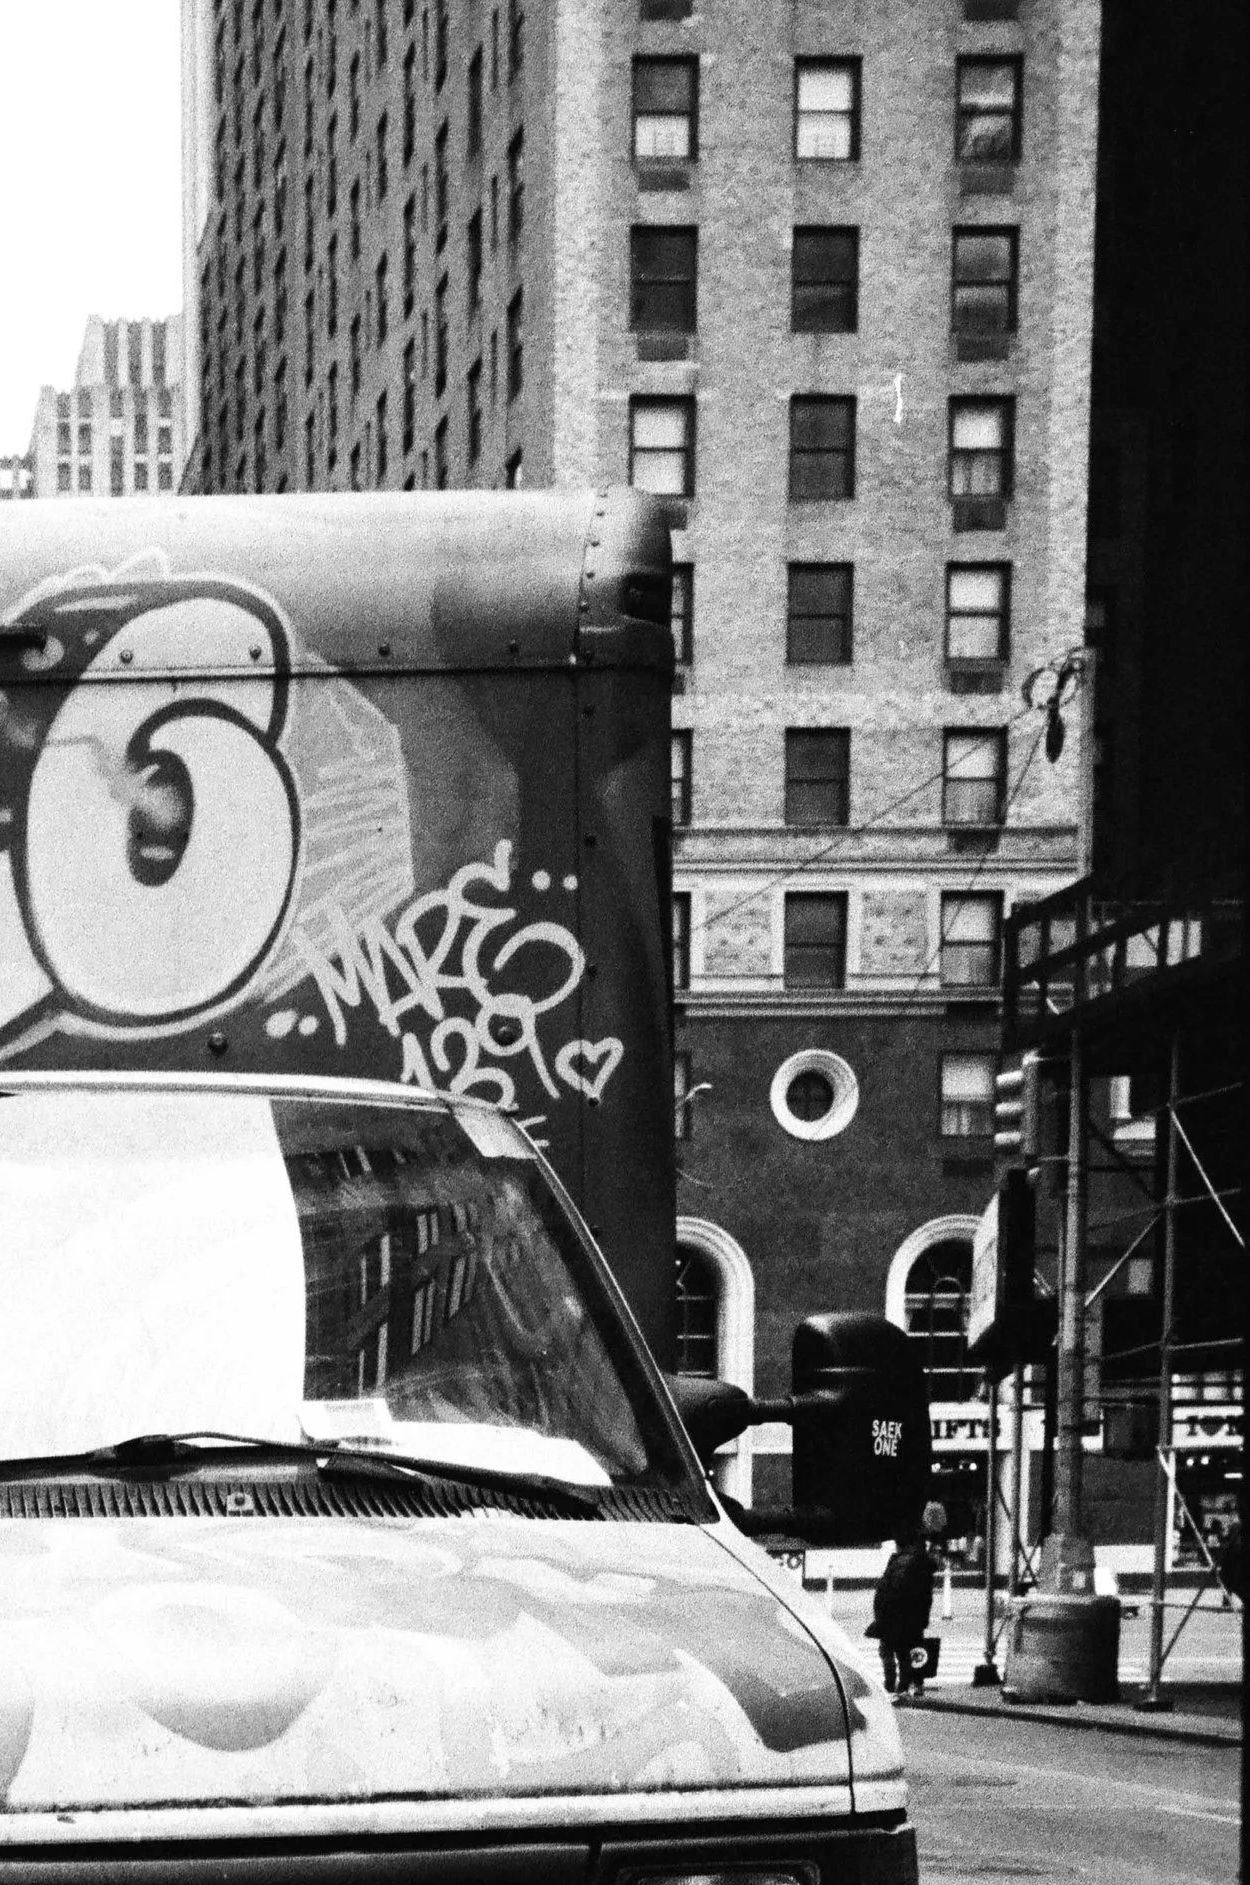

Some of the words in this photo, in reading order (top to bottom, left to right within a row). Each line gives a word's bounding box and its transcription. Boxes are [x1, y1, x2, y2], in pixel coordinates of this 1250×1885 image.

[871, 1418, 903, 1440] SAEK
[931, 1418, 1001, 1440] IFTS
[873, 1437, 898, 1457] ONE
